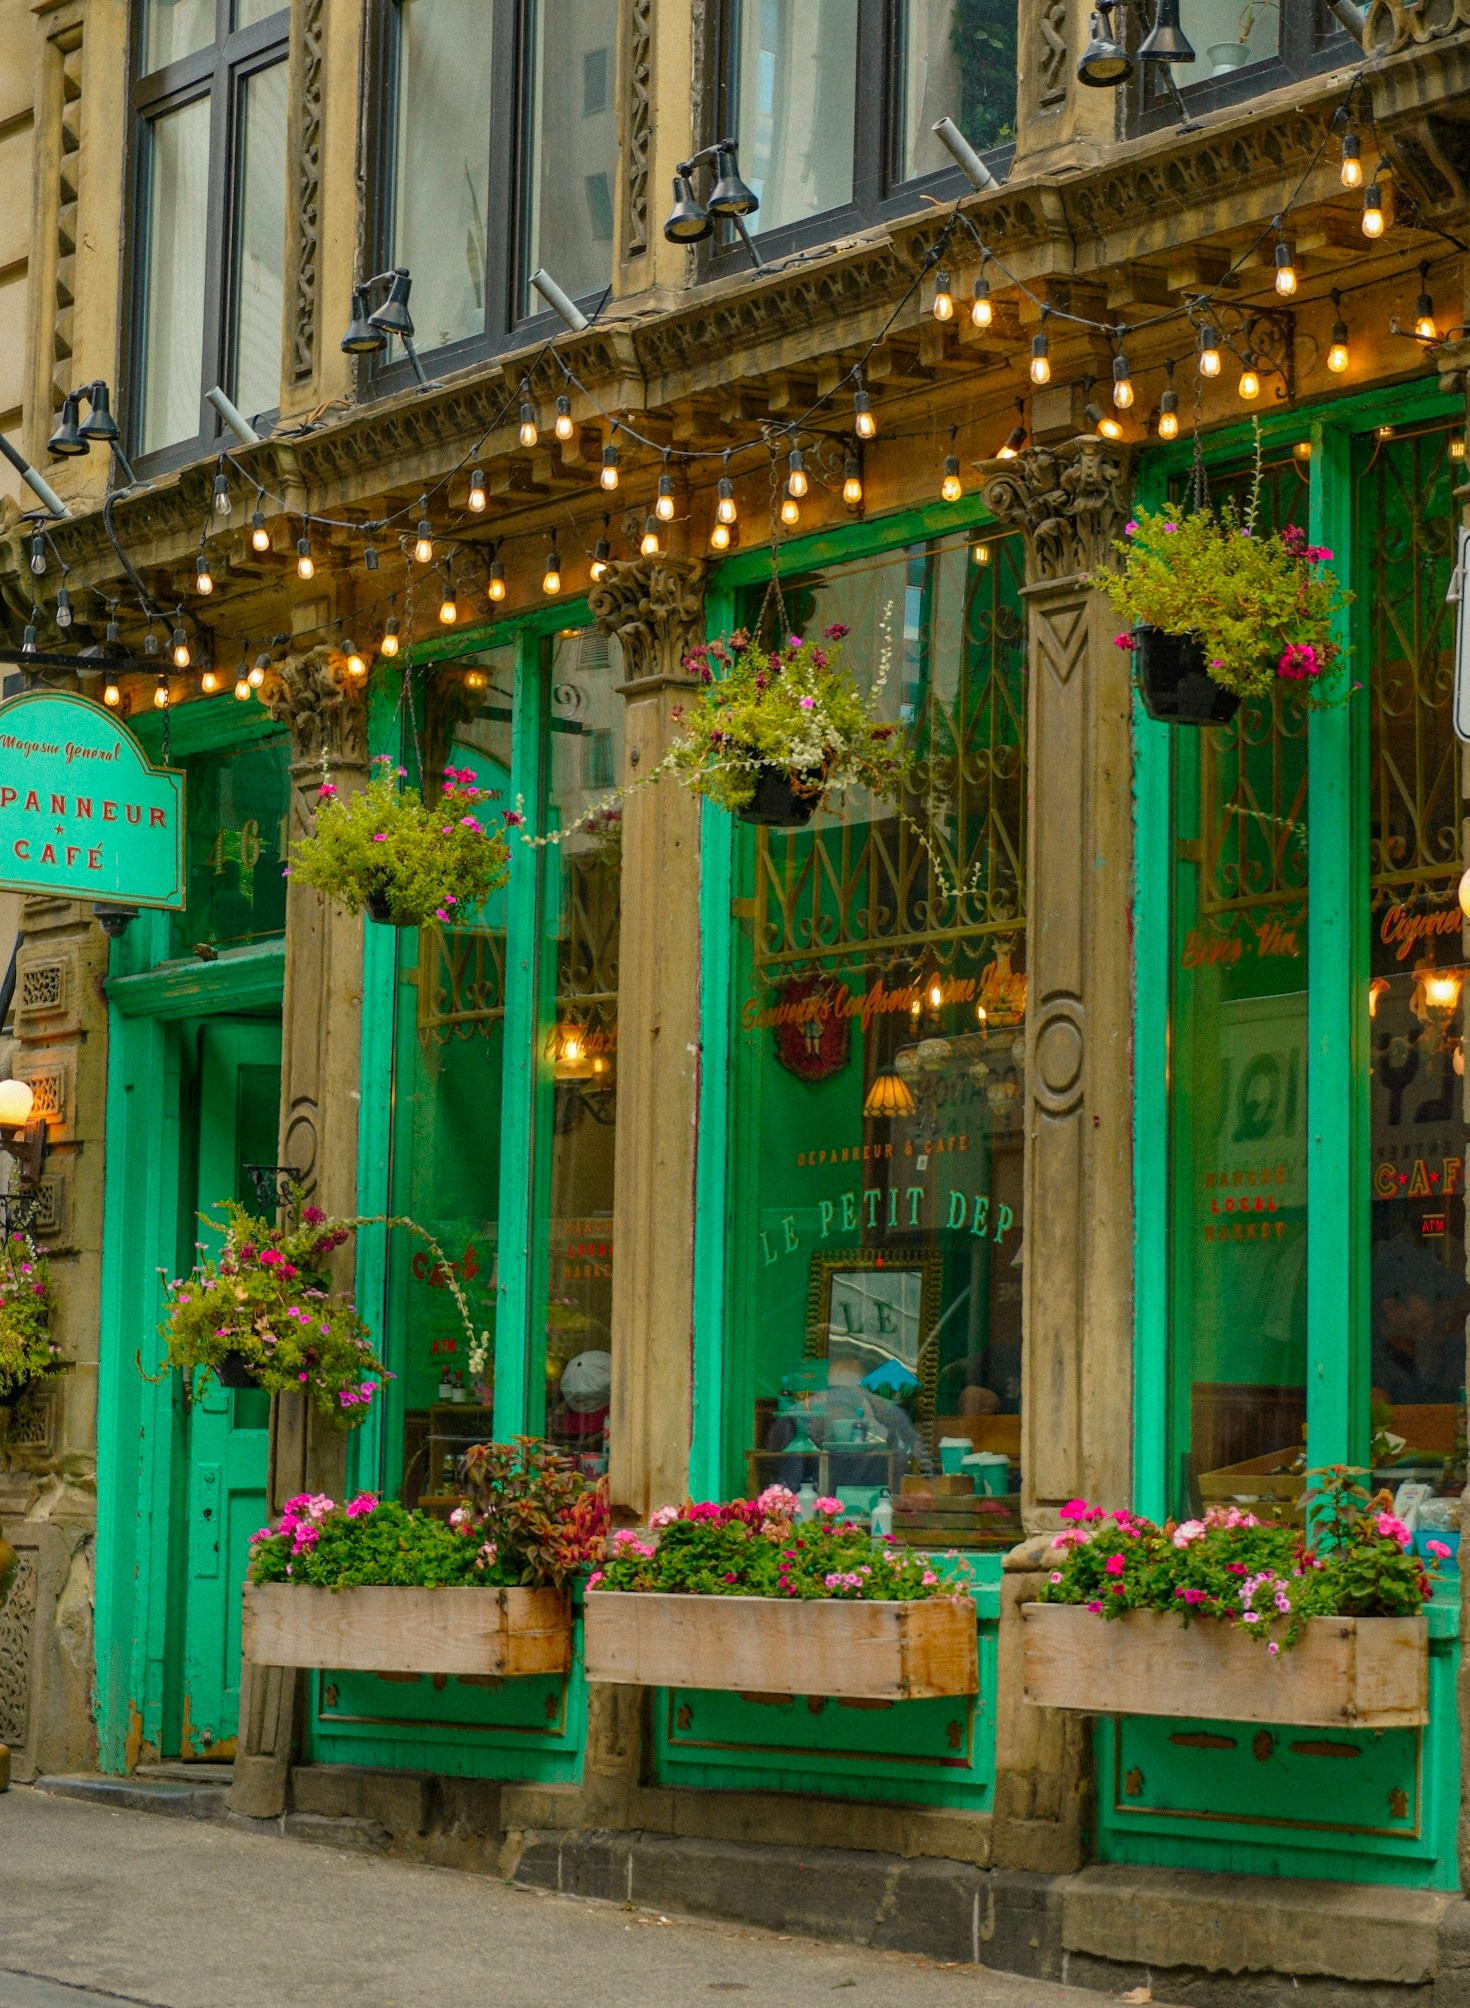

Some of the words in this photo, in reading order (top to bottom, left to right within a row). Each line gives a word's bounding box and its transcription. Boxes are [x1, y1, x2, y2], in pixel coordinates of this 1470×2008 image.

[0, 734, 59, 758] Magasin
[65, 741, 121, 764] Général
[0, 786, 167, 829] PANNEUR
[14, 840, 104, 871] CAFÉ
[1211, 1194, 1278, 1215] LOCAL
[760, 1215, 799, 1266] LE
[818, 1187, 924, 1238] PETIT
[946, 1190, 1015, 1243] DEP
[1203, 1221, 1285, 1243] MARKET
[1422, 1219, 1445, 1233] ATM
